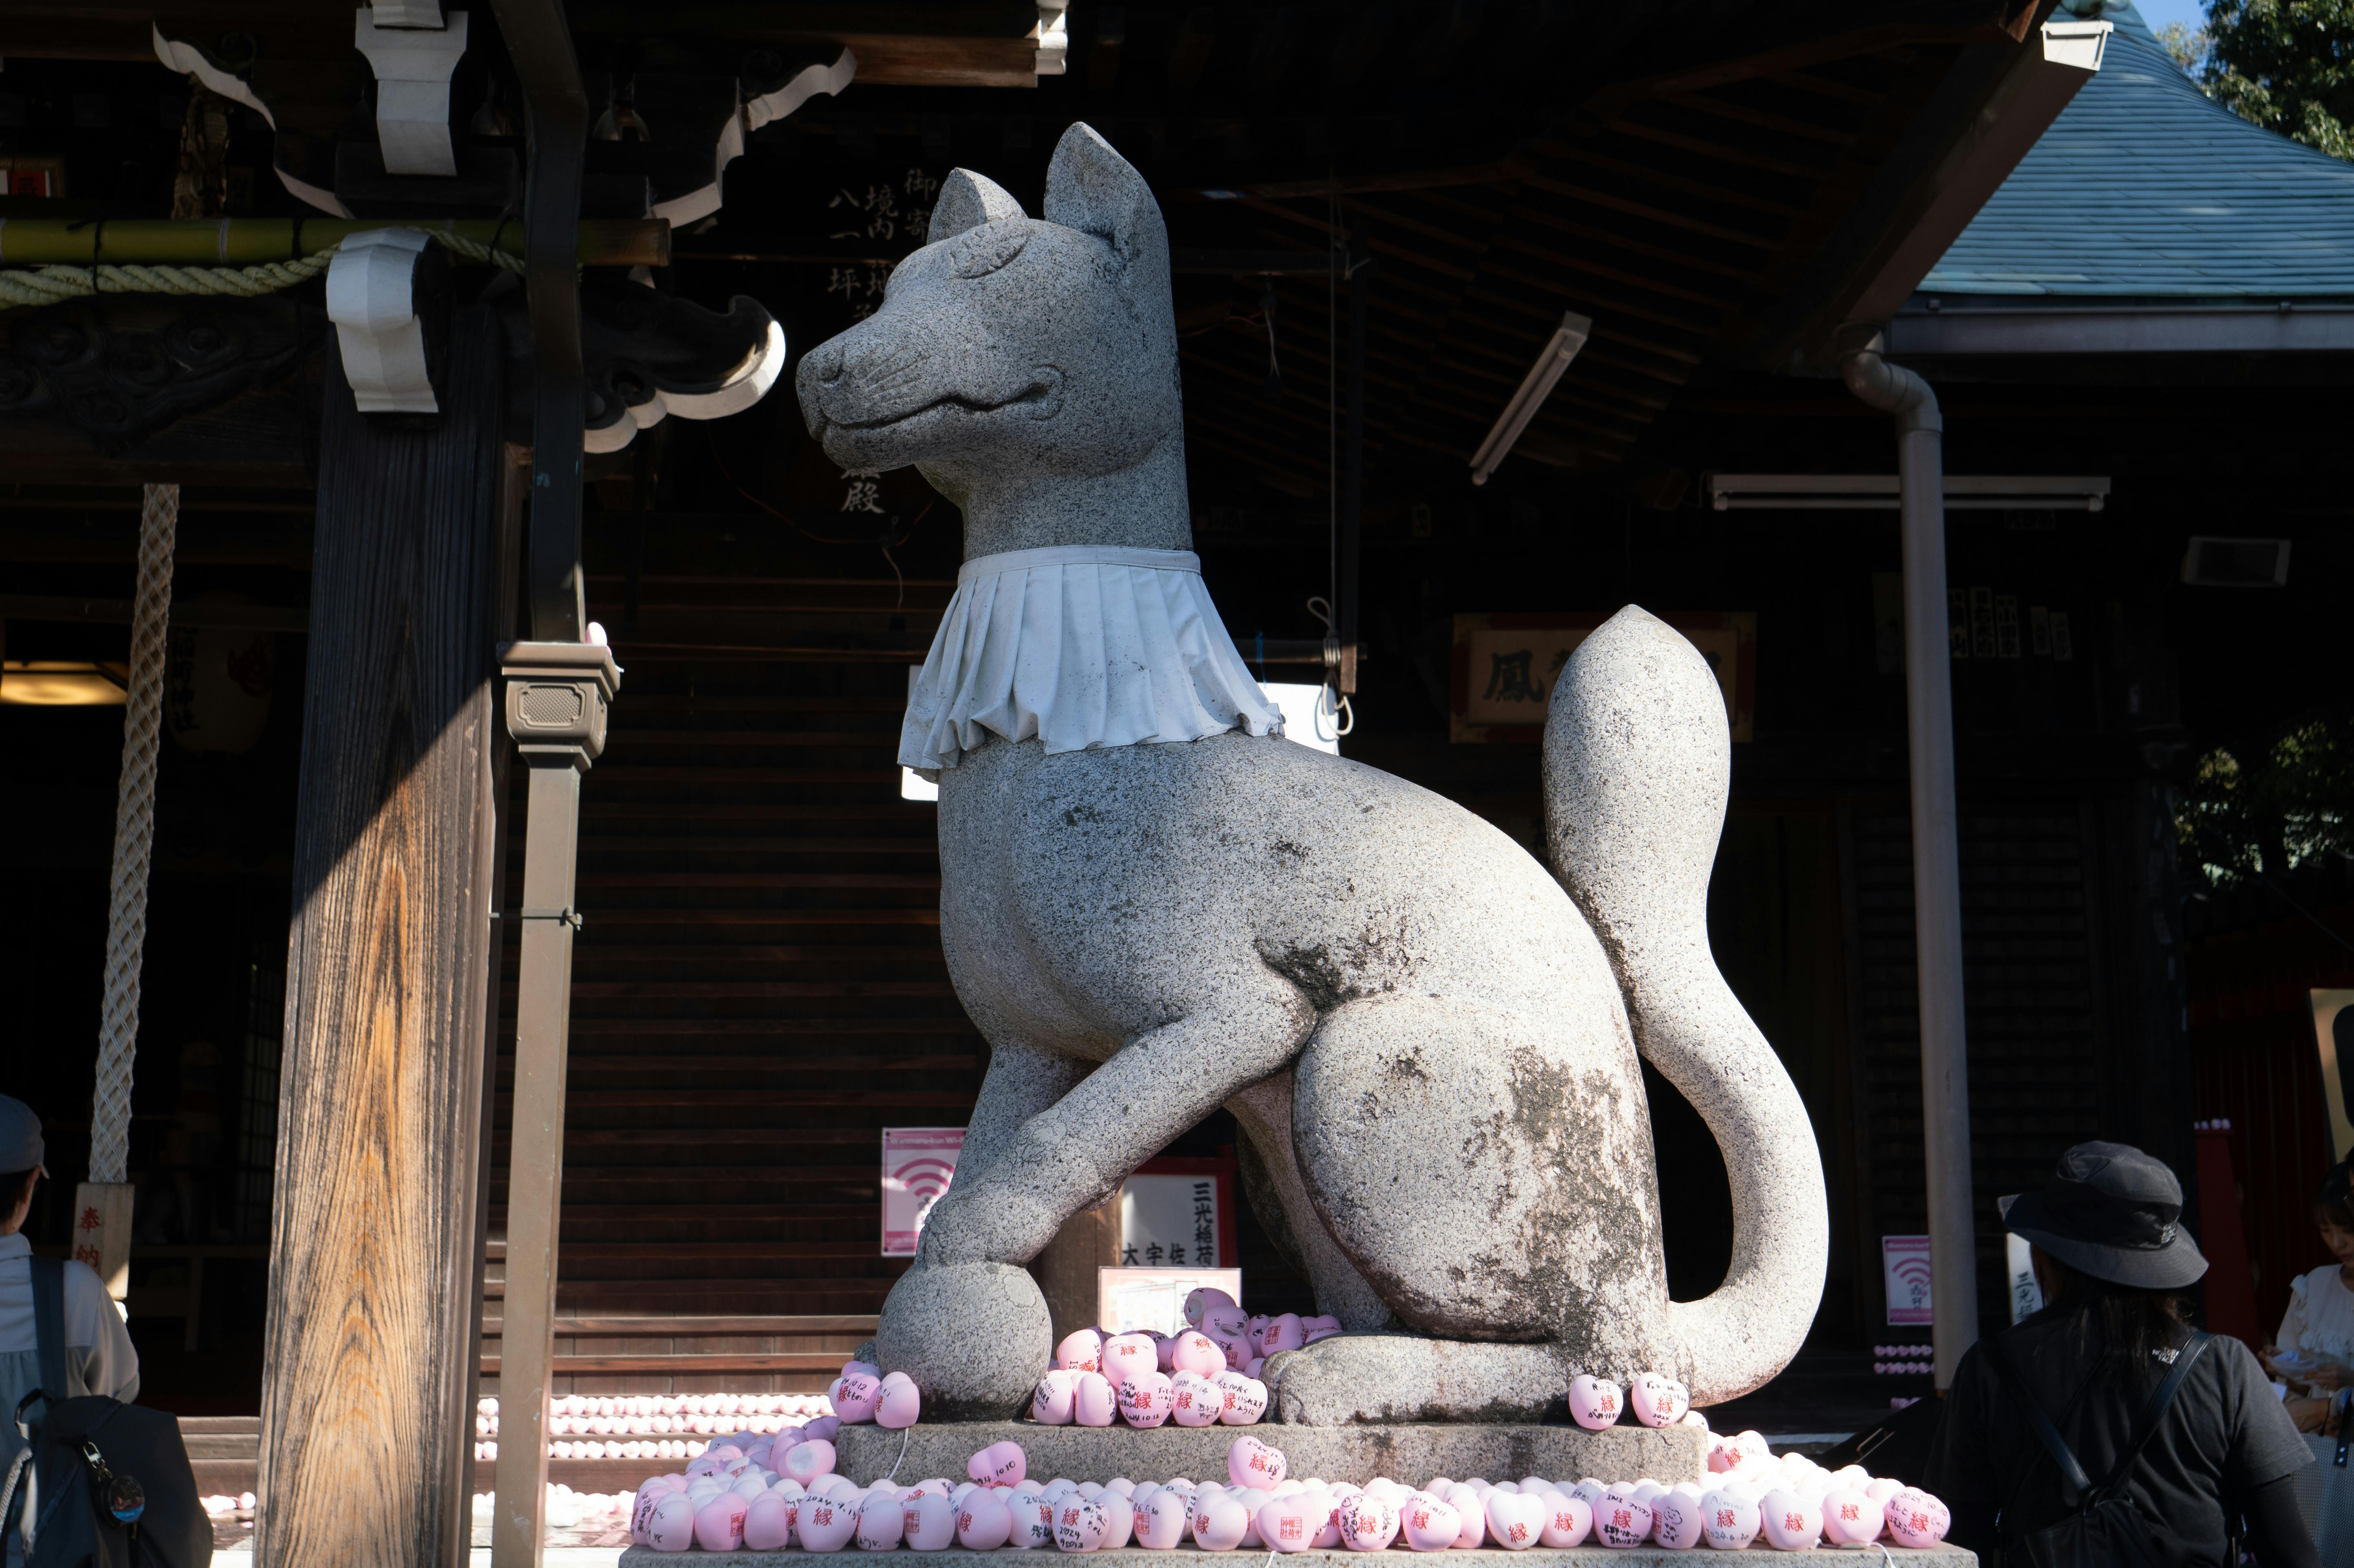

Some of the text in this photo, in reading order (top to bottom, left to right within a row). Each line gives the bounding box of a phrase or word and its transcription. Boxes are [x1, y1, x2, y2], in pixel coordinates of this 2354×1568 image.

[77, 1206, 101, 1268] 奉納
[1120, 1346, 1138, 1356] 縁
[838, 1385, 849, 1403] 縁
[1135, 1390, 1152, 1409] 縁
[1176, 1391, 1193, 1409] 縁
[1600, 1394, 1617, 1413] 縁
[1237, 1406, 1254, 1416] ように
[1655, 1395, 1674, 1414] 縁
[1249, 1452, 1267, 1472] 縁
[1724, 1447, 1743, 1468] 縁
[813, 1506, 833, 1526] 縁
[958, 1510, 973, 1533] 縁
[1040, 1504, 1053, 1524] 縁
[1061, 1506, 1080, 1526] 縁
[1411, 1509, 1430, 1530] 縁
[1554, 1512, 1574, 1532] 縁
[1612, 1508, 1632, 1528] 縁
[1717, 1509, 1736, 1528] 縁
[1784, 1512, 1804, 1532] 縁
[1840, 1503, 1860, 1521] 縁
[1909, 1511, 1929, 1533] 縁
[1195, 1512, 1210, 1535] 縁
[1357, 1515, 1378, 1534] 縁
[1508, 1522, 1530, 1543] 縁
